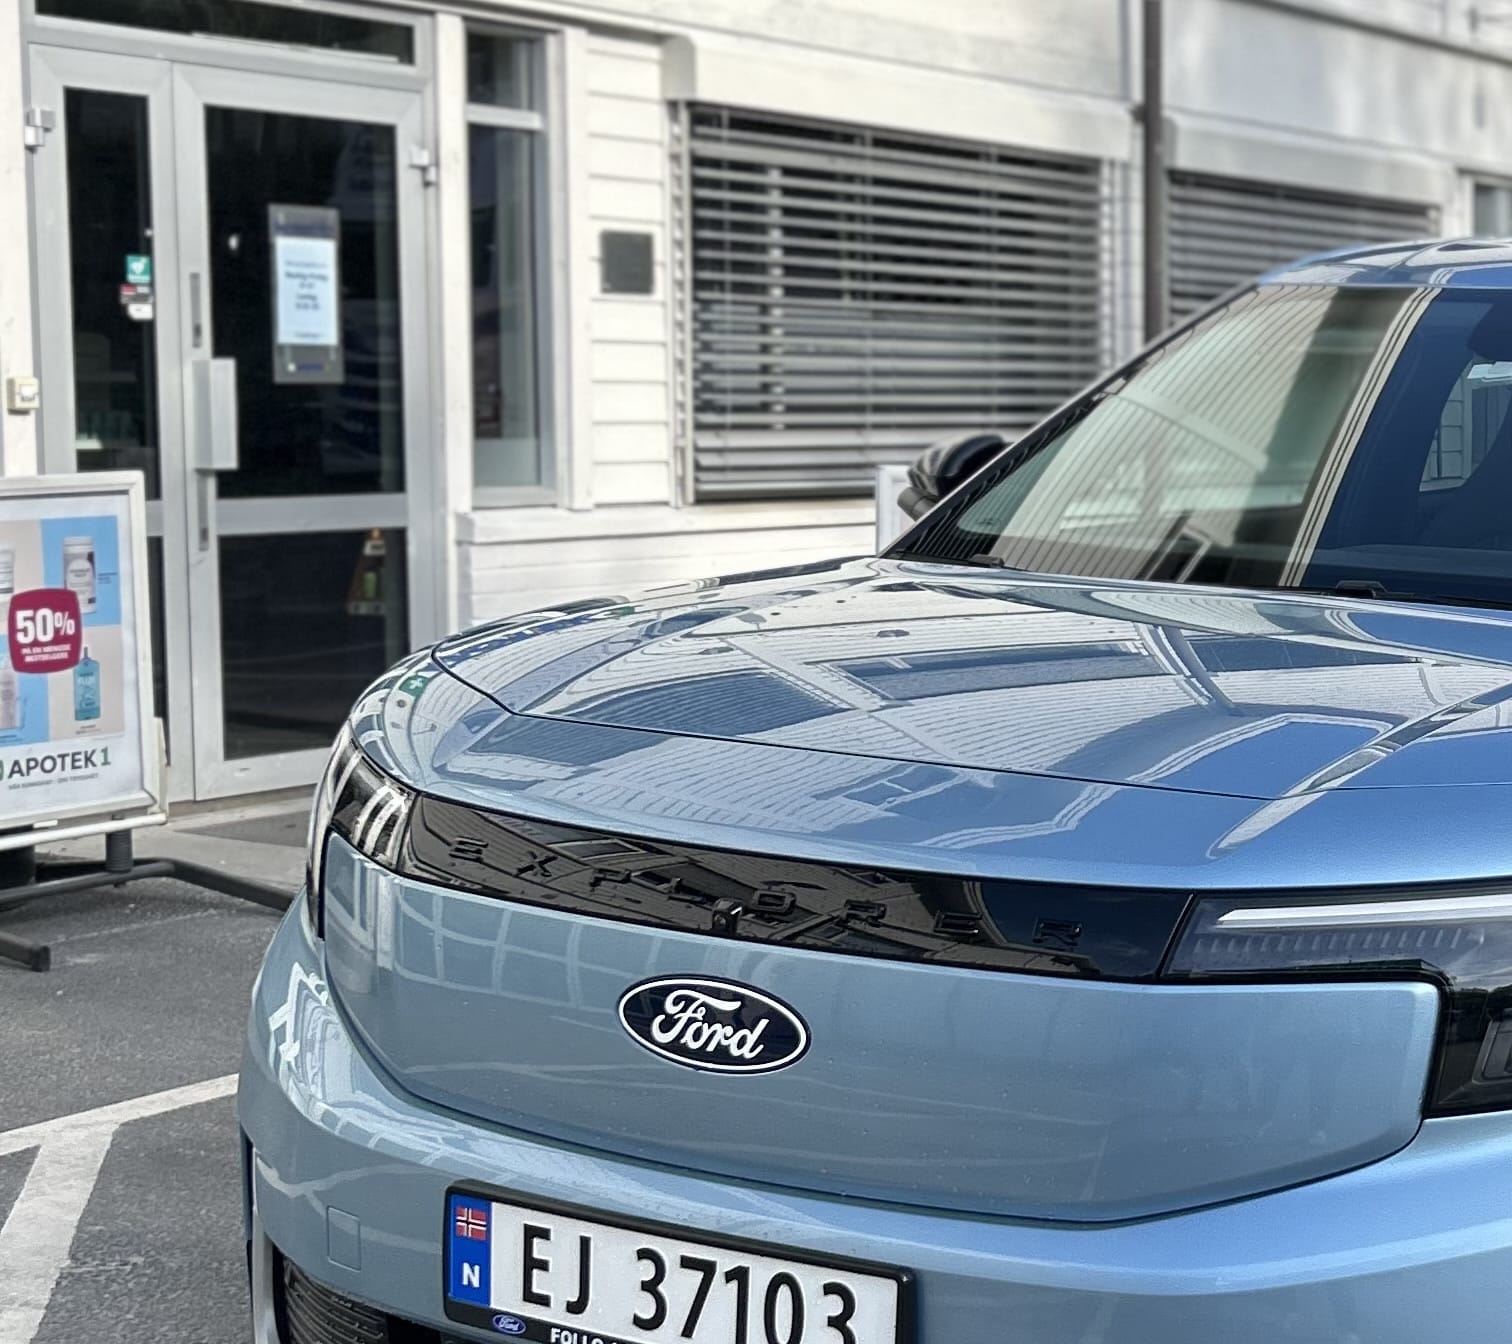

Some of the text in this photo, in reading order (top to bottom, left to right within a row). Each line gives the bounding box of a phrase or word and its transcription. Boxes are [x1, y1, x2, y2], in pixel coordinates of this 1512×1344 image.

[16, 607, 76, 645] 50%
[8, 745, 112, 779] APOTEK 1
[652, 989, 769, 1059] Ford
[462, 1262, 481, 1289] N
[522, 1223, 591, 1315] EJ
